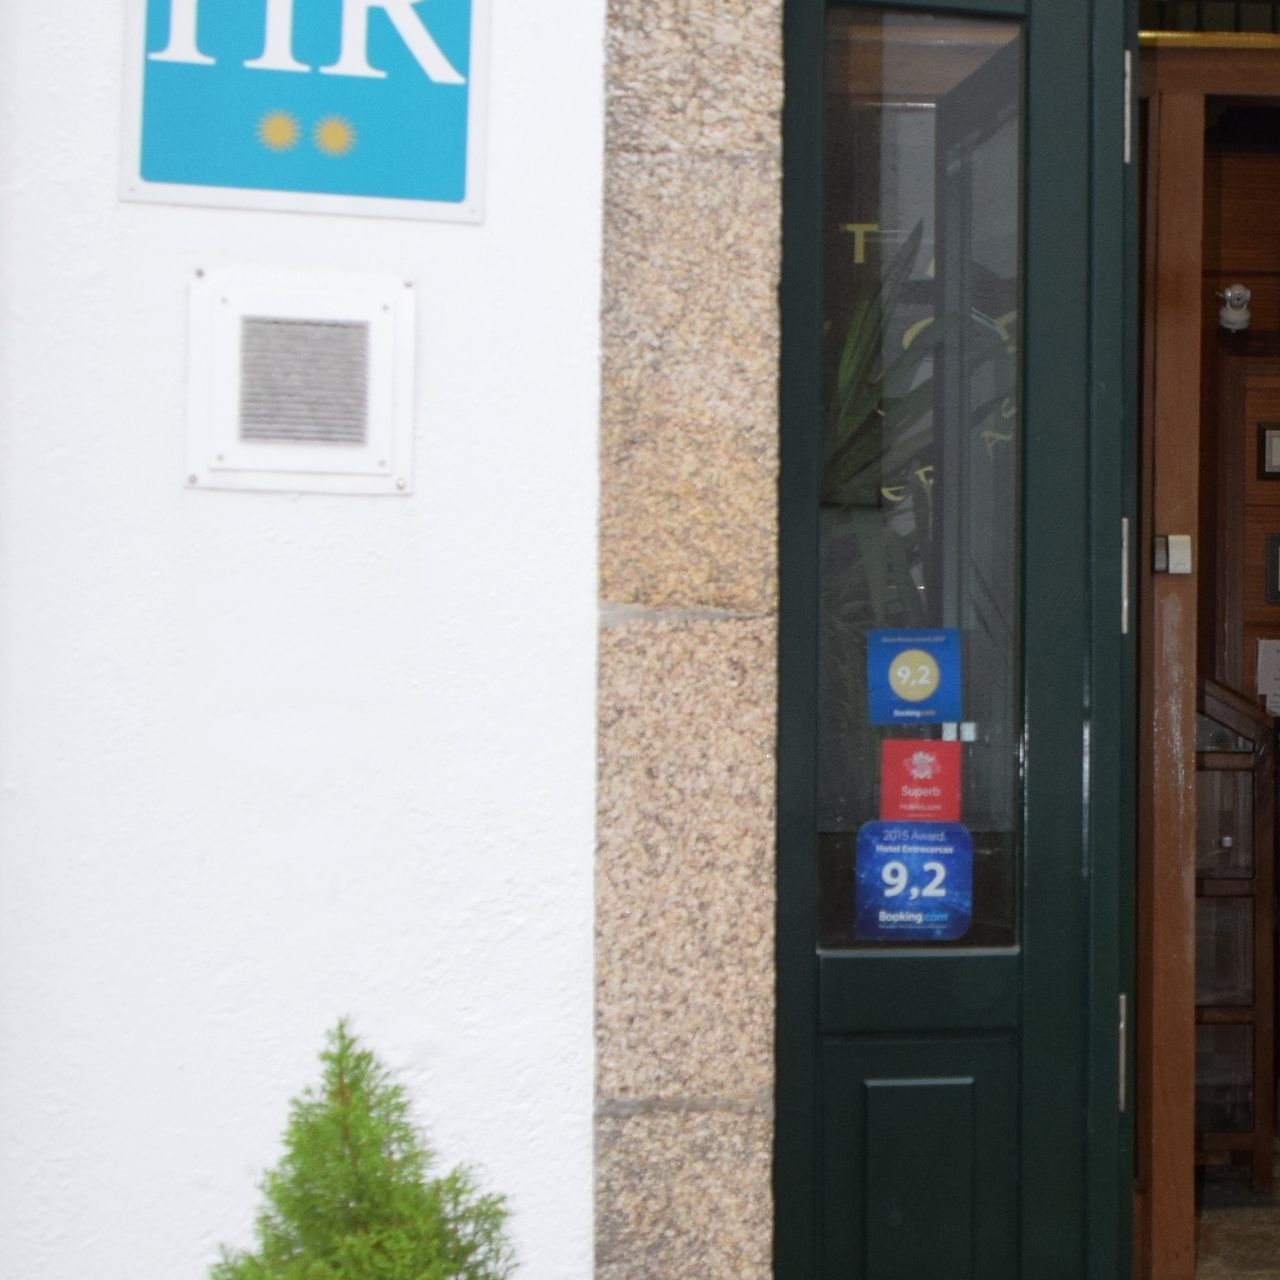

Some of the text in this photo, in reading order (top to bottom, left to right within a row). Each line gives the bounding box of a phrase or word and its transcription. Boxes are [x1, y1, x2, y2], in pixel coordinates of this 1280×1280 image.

[897, 665, 931, 687] 9,2
[901, 785, 941, 799] Superb
[883, 829, 909, 841] 2015
[876, 845, 900, 854] Hotel
[881, 861, 946, 900] 9,2
